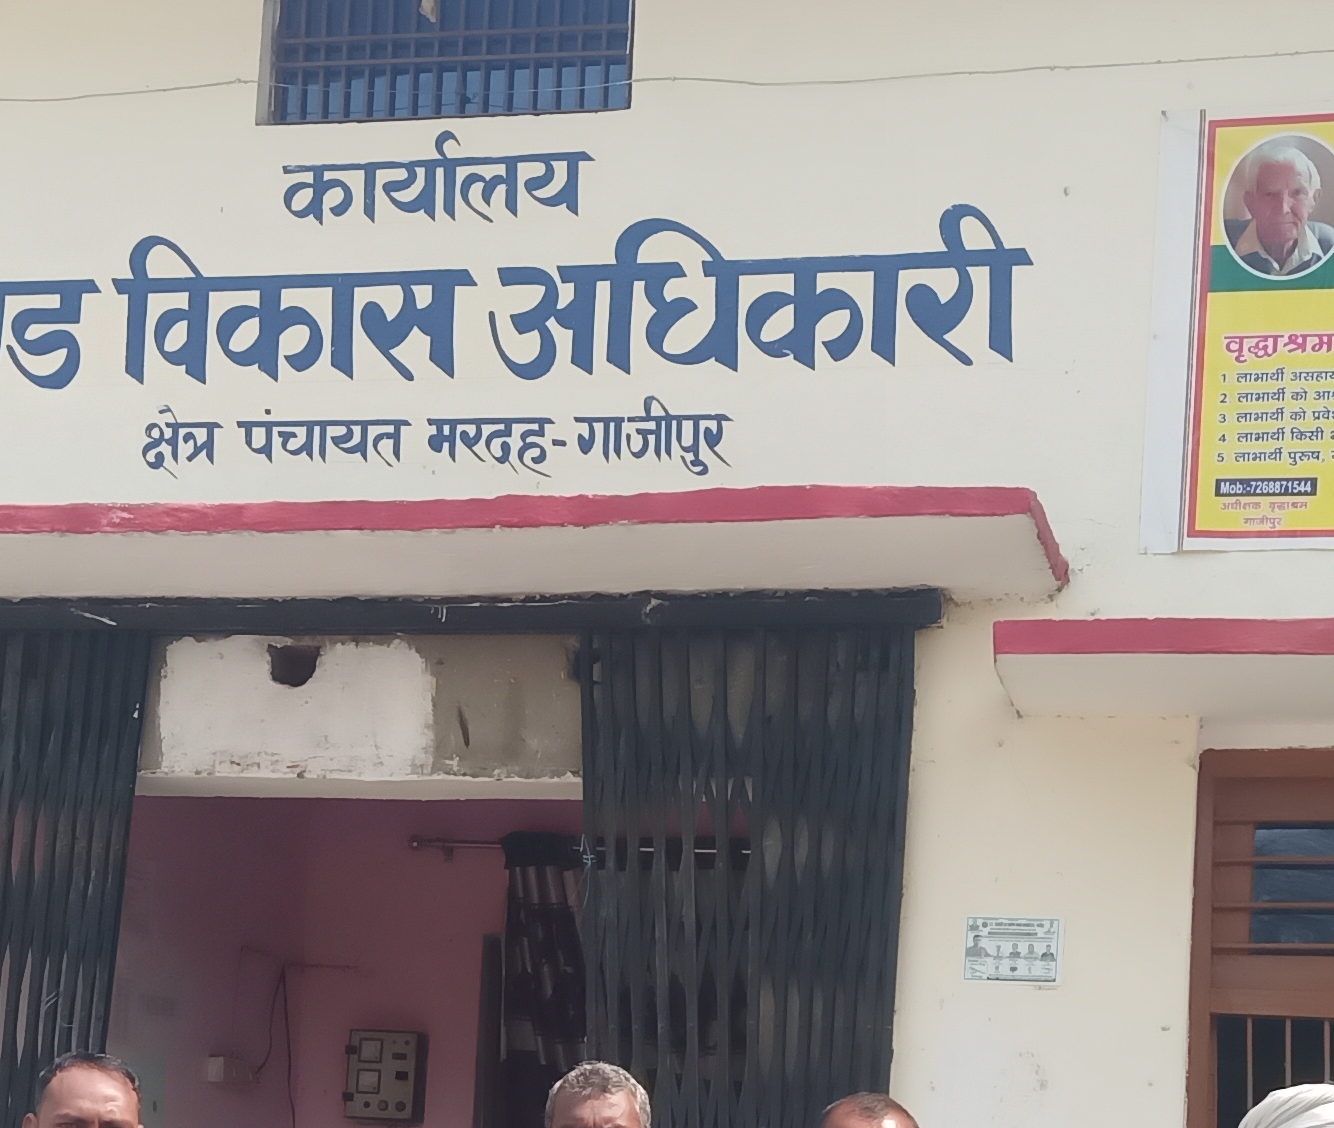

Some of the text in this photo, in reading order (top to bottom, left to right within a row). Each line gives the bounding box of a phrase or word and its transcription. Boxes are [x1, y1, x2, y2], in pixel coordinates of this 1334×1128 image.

[282, 130, 596, 226] कार्यालय
[114, 236, 476, 383] विकास
[489, 203, 1035, 380] अधिकारी
[1236, 366, 1285, 383] लाभार्थी
[1236, 386, 1286, 403] लाभार्थी
[1290, 387, 1308, 401] को
[1235, 406, 1285, 423] लाभार्थी
[1289, 406, 1307, 421] को
[142, 395, 731, 479] क्षेत्र पंचायत मरदह-गाजीपुर
[1220, 480, 1312, 495] Mob:-7268871544
